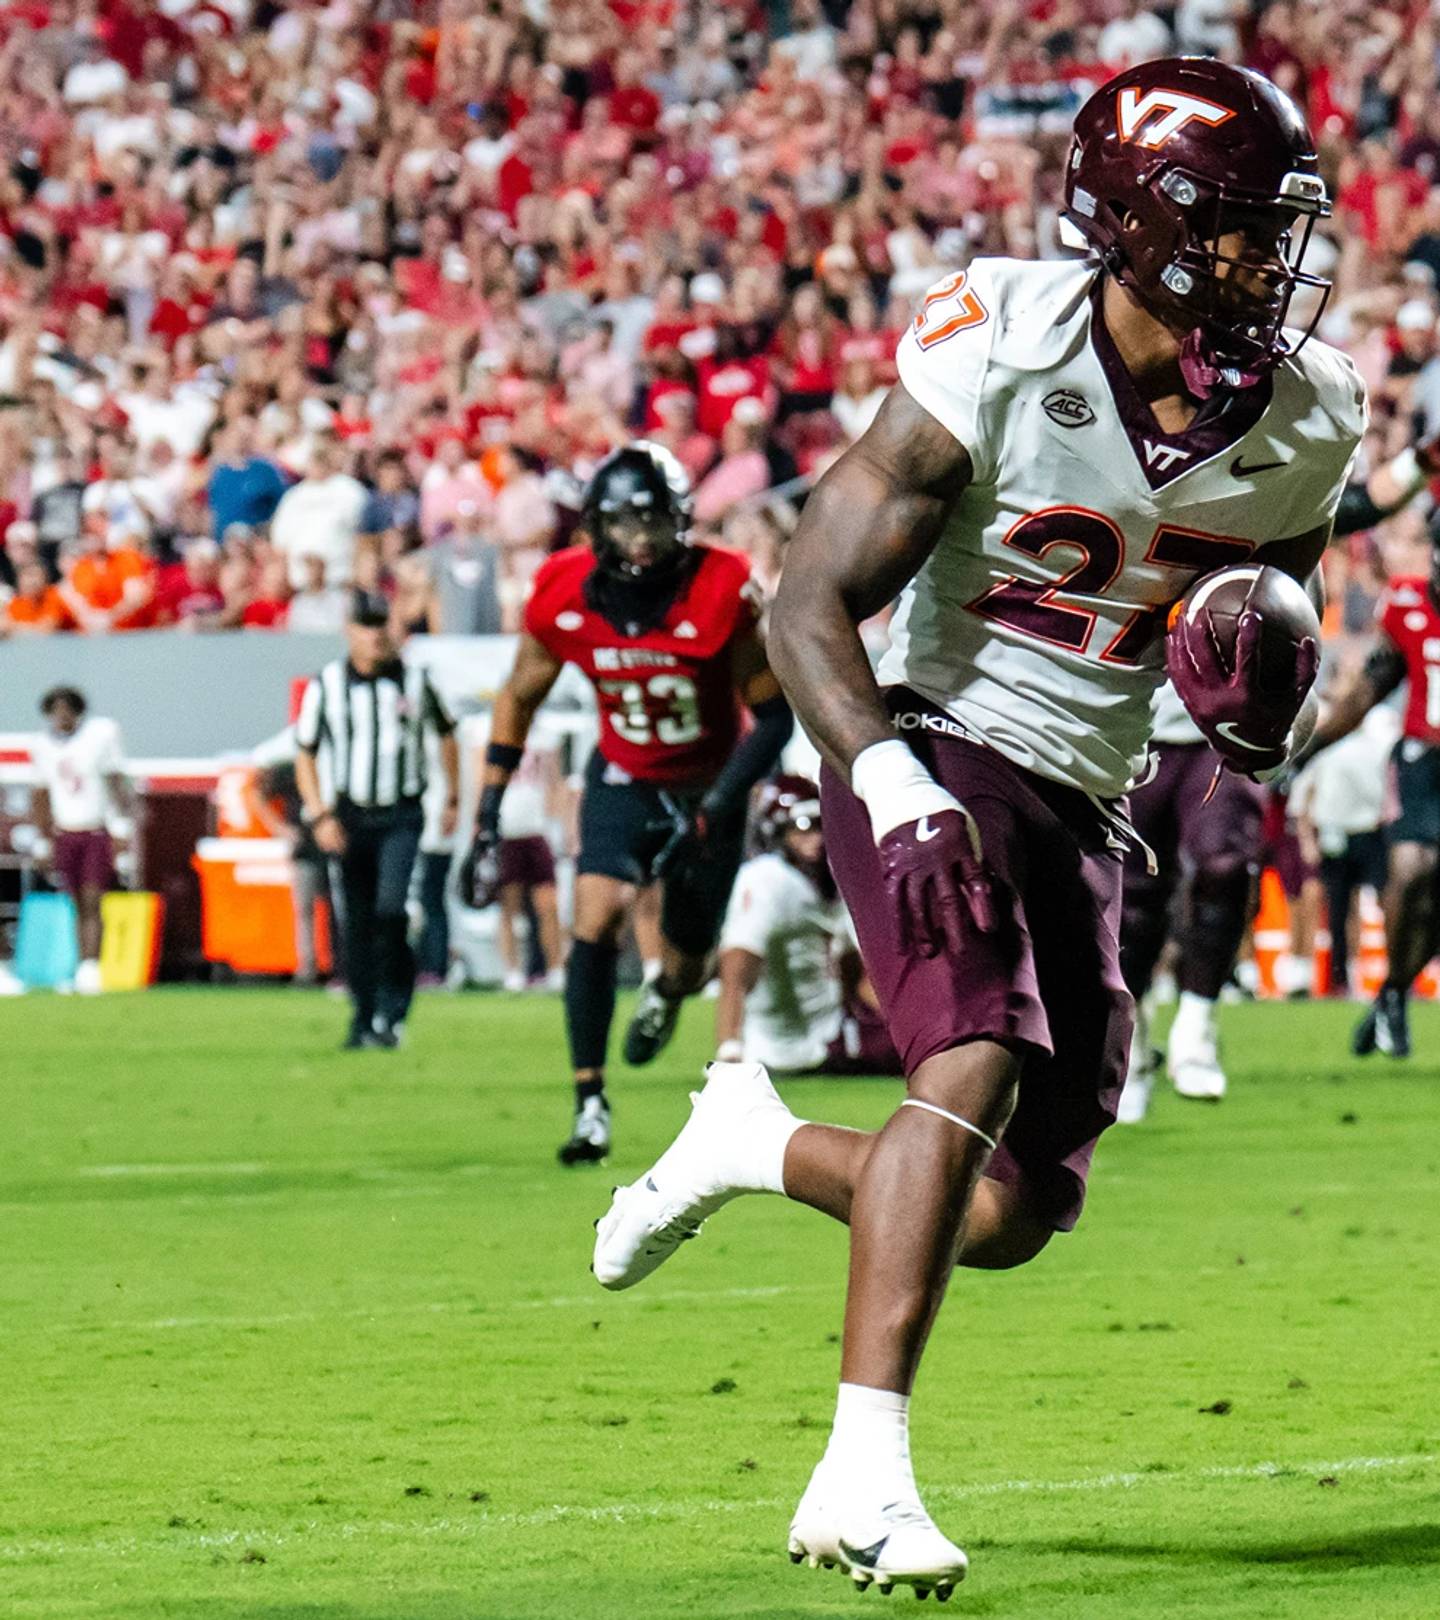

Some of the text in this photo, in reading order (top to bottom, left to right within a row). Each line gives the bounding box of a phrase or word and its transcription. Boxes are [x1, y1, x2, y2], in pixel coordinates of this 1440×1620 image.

[1117, 87, 1237, 150] VT
[1052, 398, 1087, 420] ACC
[1143, 439, 1191, 471] VT
[964, 505, 1255, 662] 27
